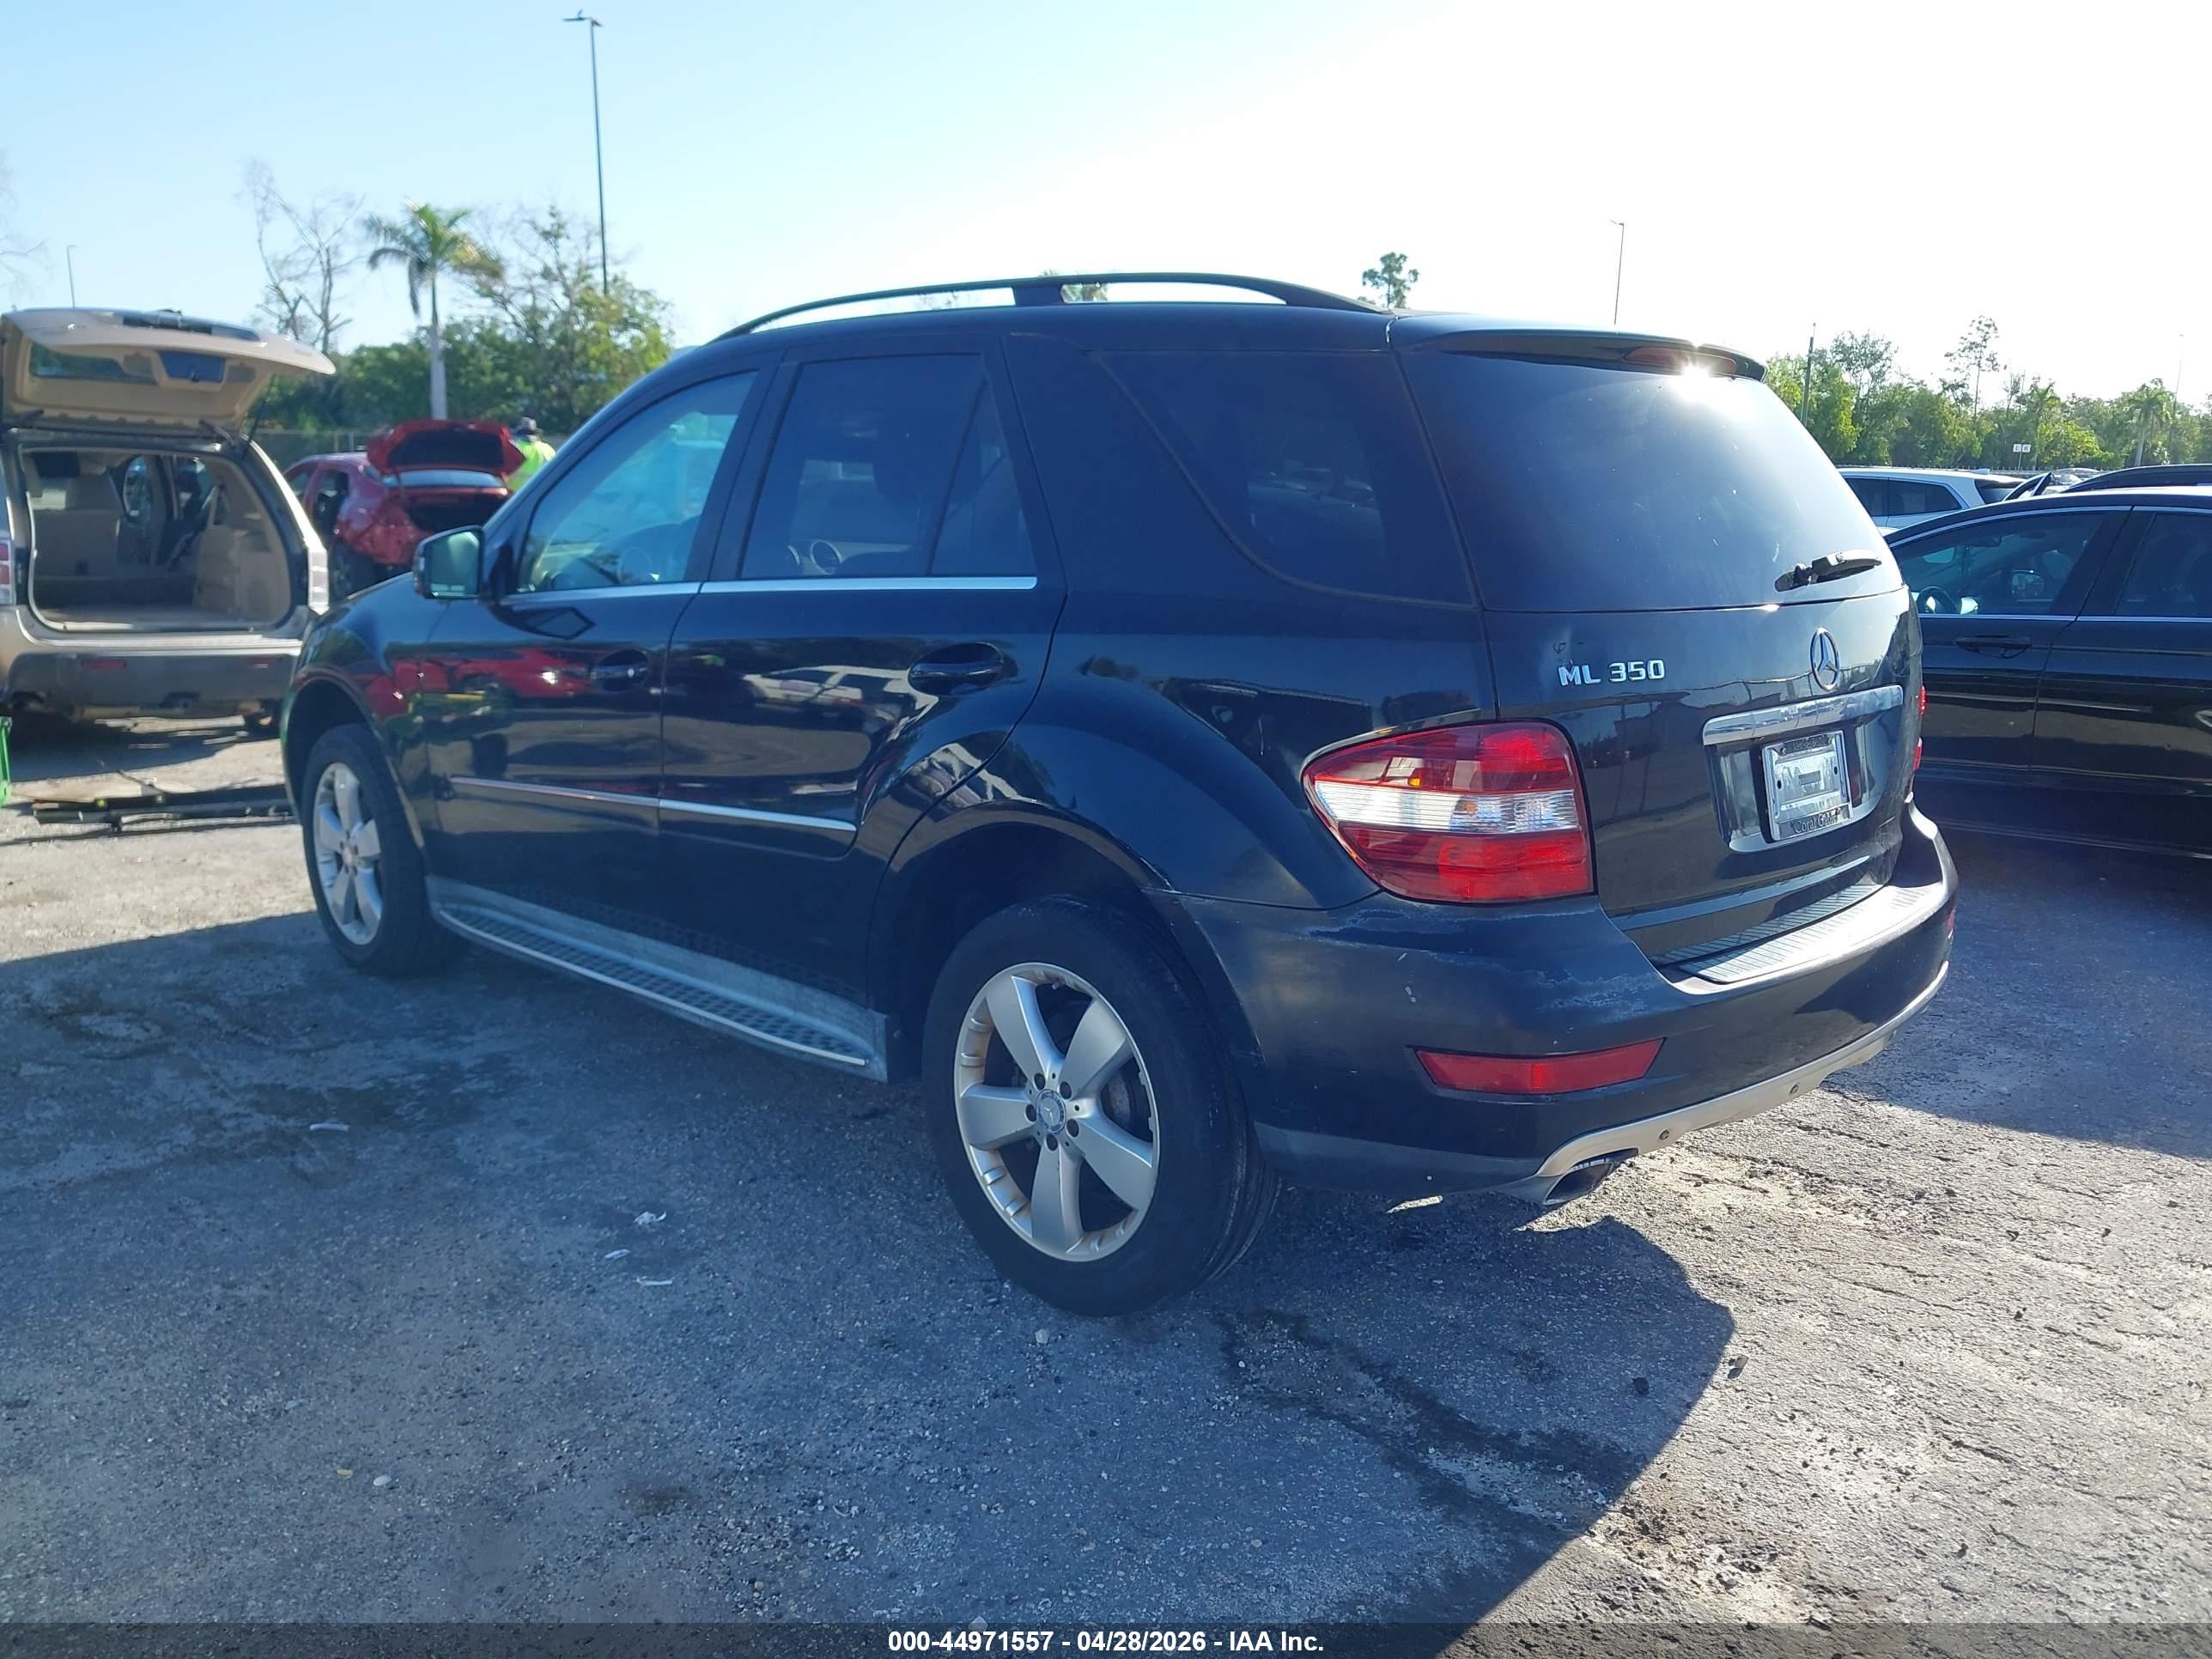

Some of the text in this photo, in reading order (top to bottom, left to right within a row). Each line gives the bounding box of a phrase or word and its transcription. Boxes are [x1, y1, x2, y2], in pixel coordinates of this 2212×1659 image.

[1558, 659, 1665, 686] ML 350
[1792, 816, 1817, 834] Coral
